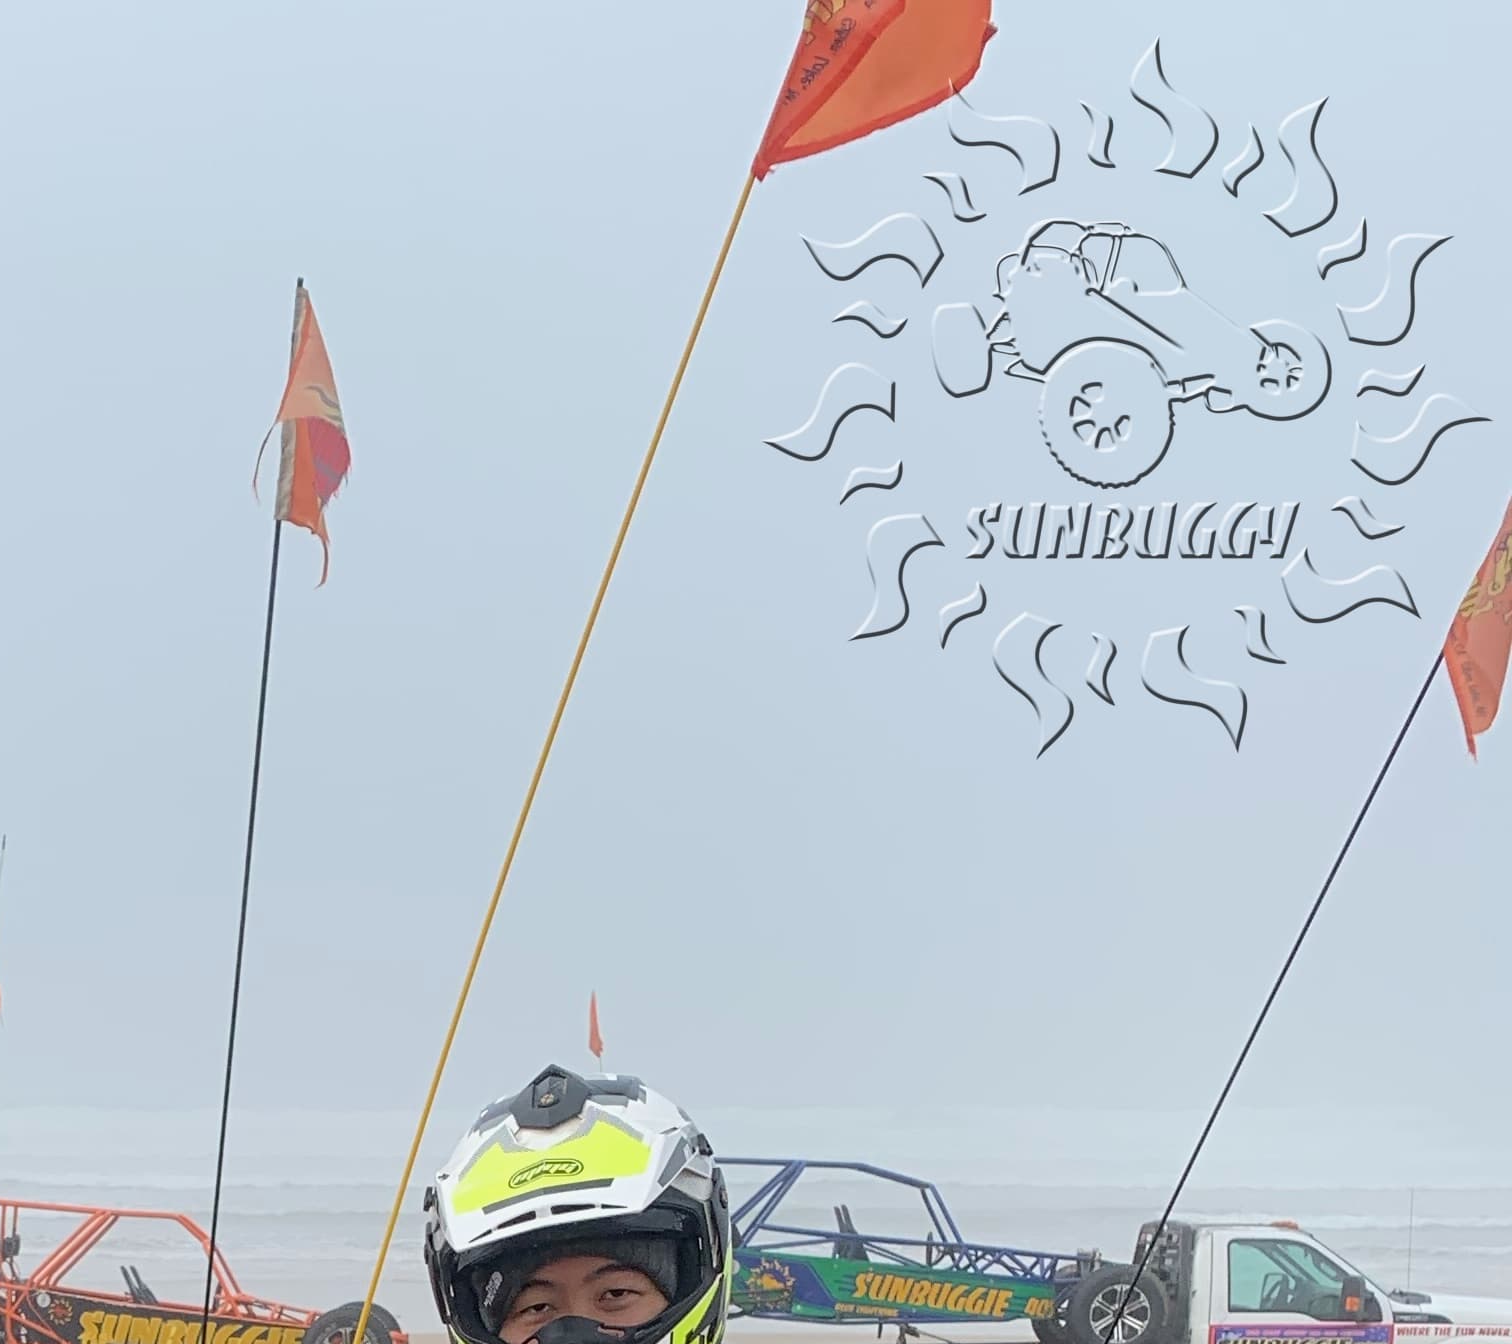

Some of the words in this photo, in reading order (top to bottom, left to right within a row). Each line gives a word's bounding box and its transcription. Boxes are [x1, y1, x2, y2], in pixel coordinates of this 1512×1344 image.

[852, 1271, 1013, 1318] SUNBUGGIE
[1396, 1326, 1430, 1338] WHERE
[1434, 1326, 1452, 1338] THE
[1455, 1326, 1476, 1338] FUN
[1478, 1326, 1511, 1338] NEVER
